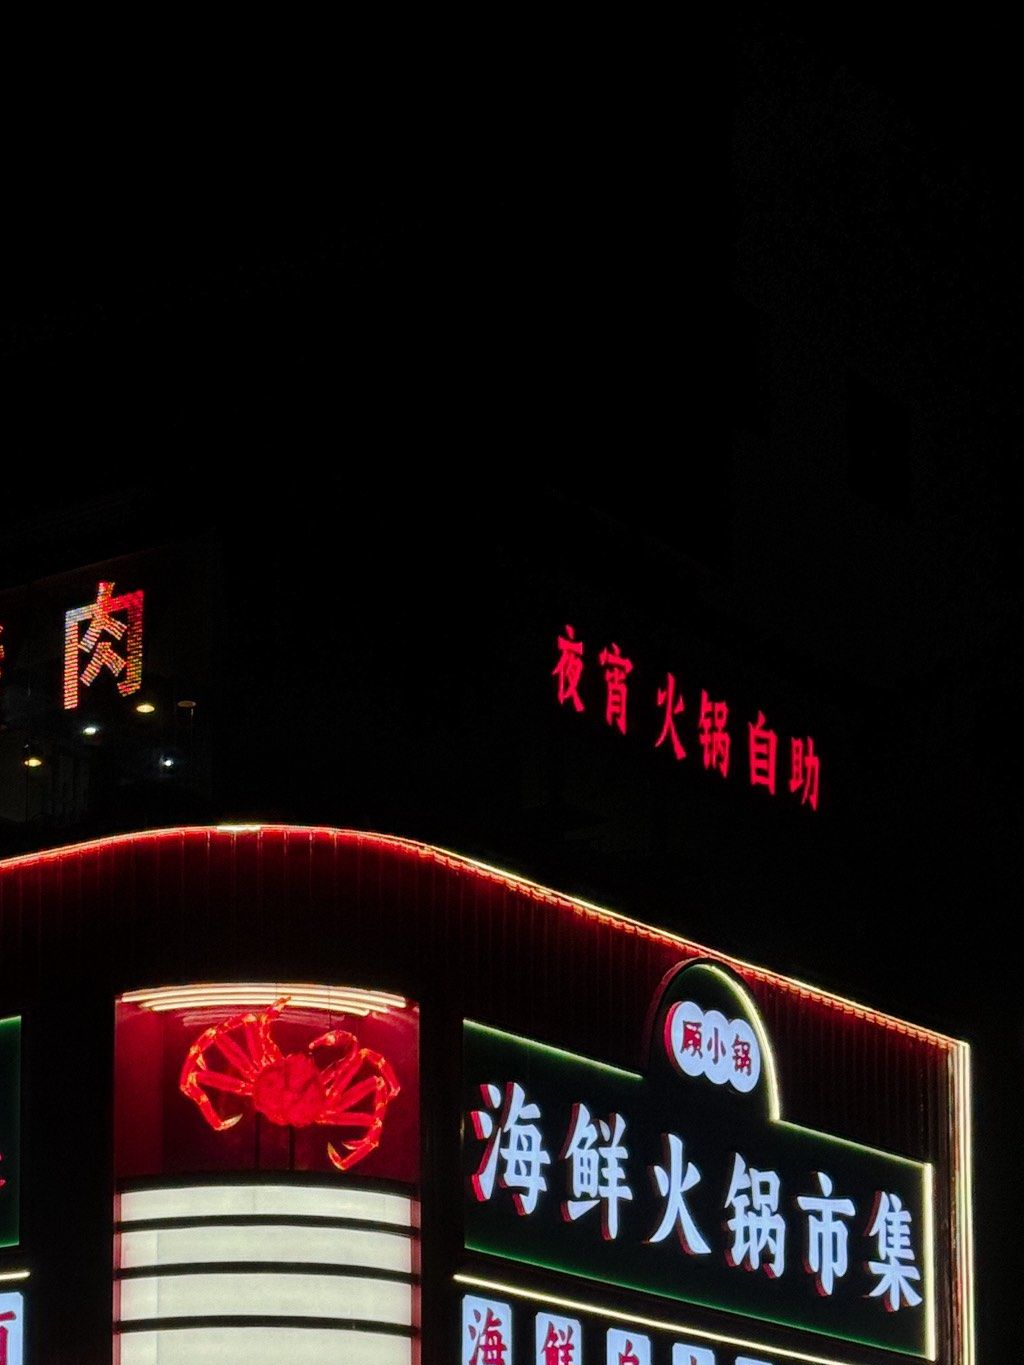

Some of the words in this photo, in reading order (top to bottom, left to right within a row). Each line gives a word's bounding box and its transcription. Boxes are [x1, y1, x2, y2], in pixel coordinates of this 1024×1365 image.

[552, 624, 820, 811] 夜宵火锅自助
[679, 1020, 754, 1077] 顾小锅
[471, 1081, 923, 1312] 海鲜火锅市集
